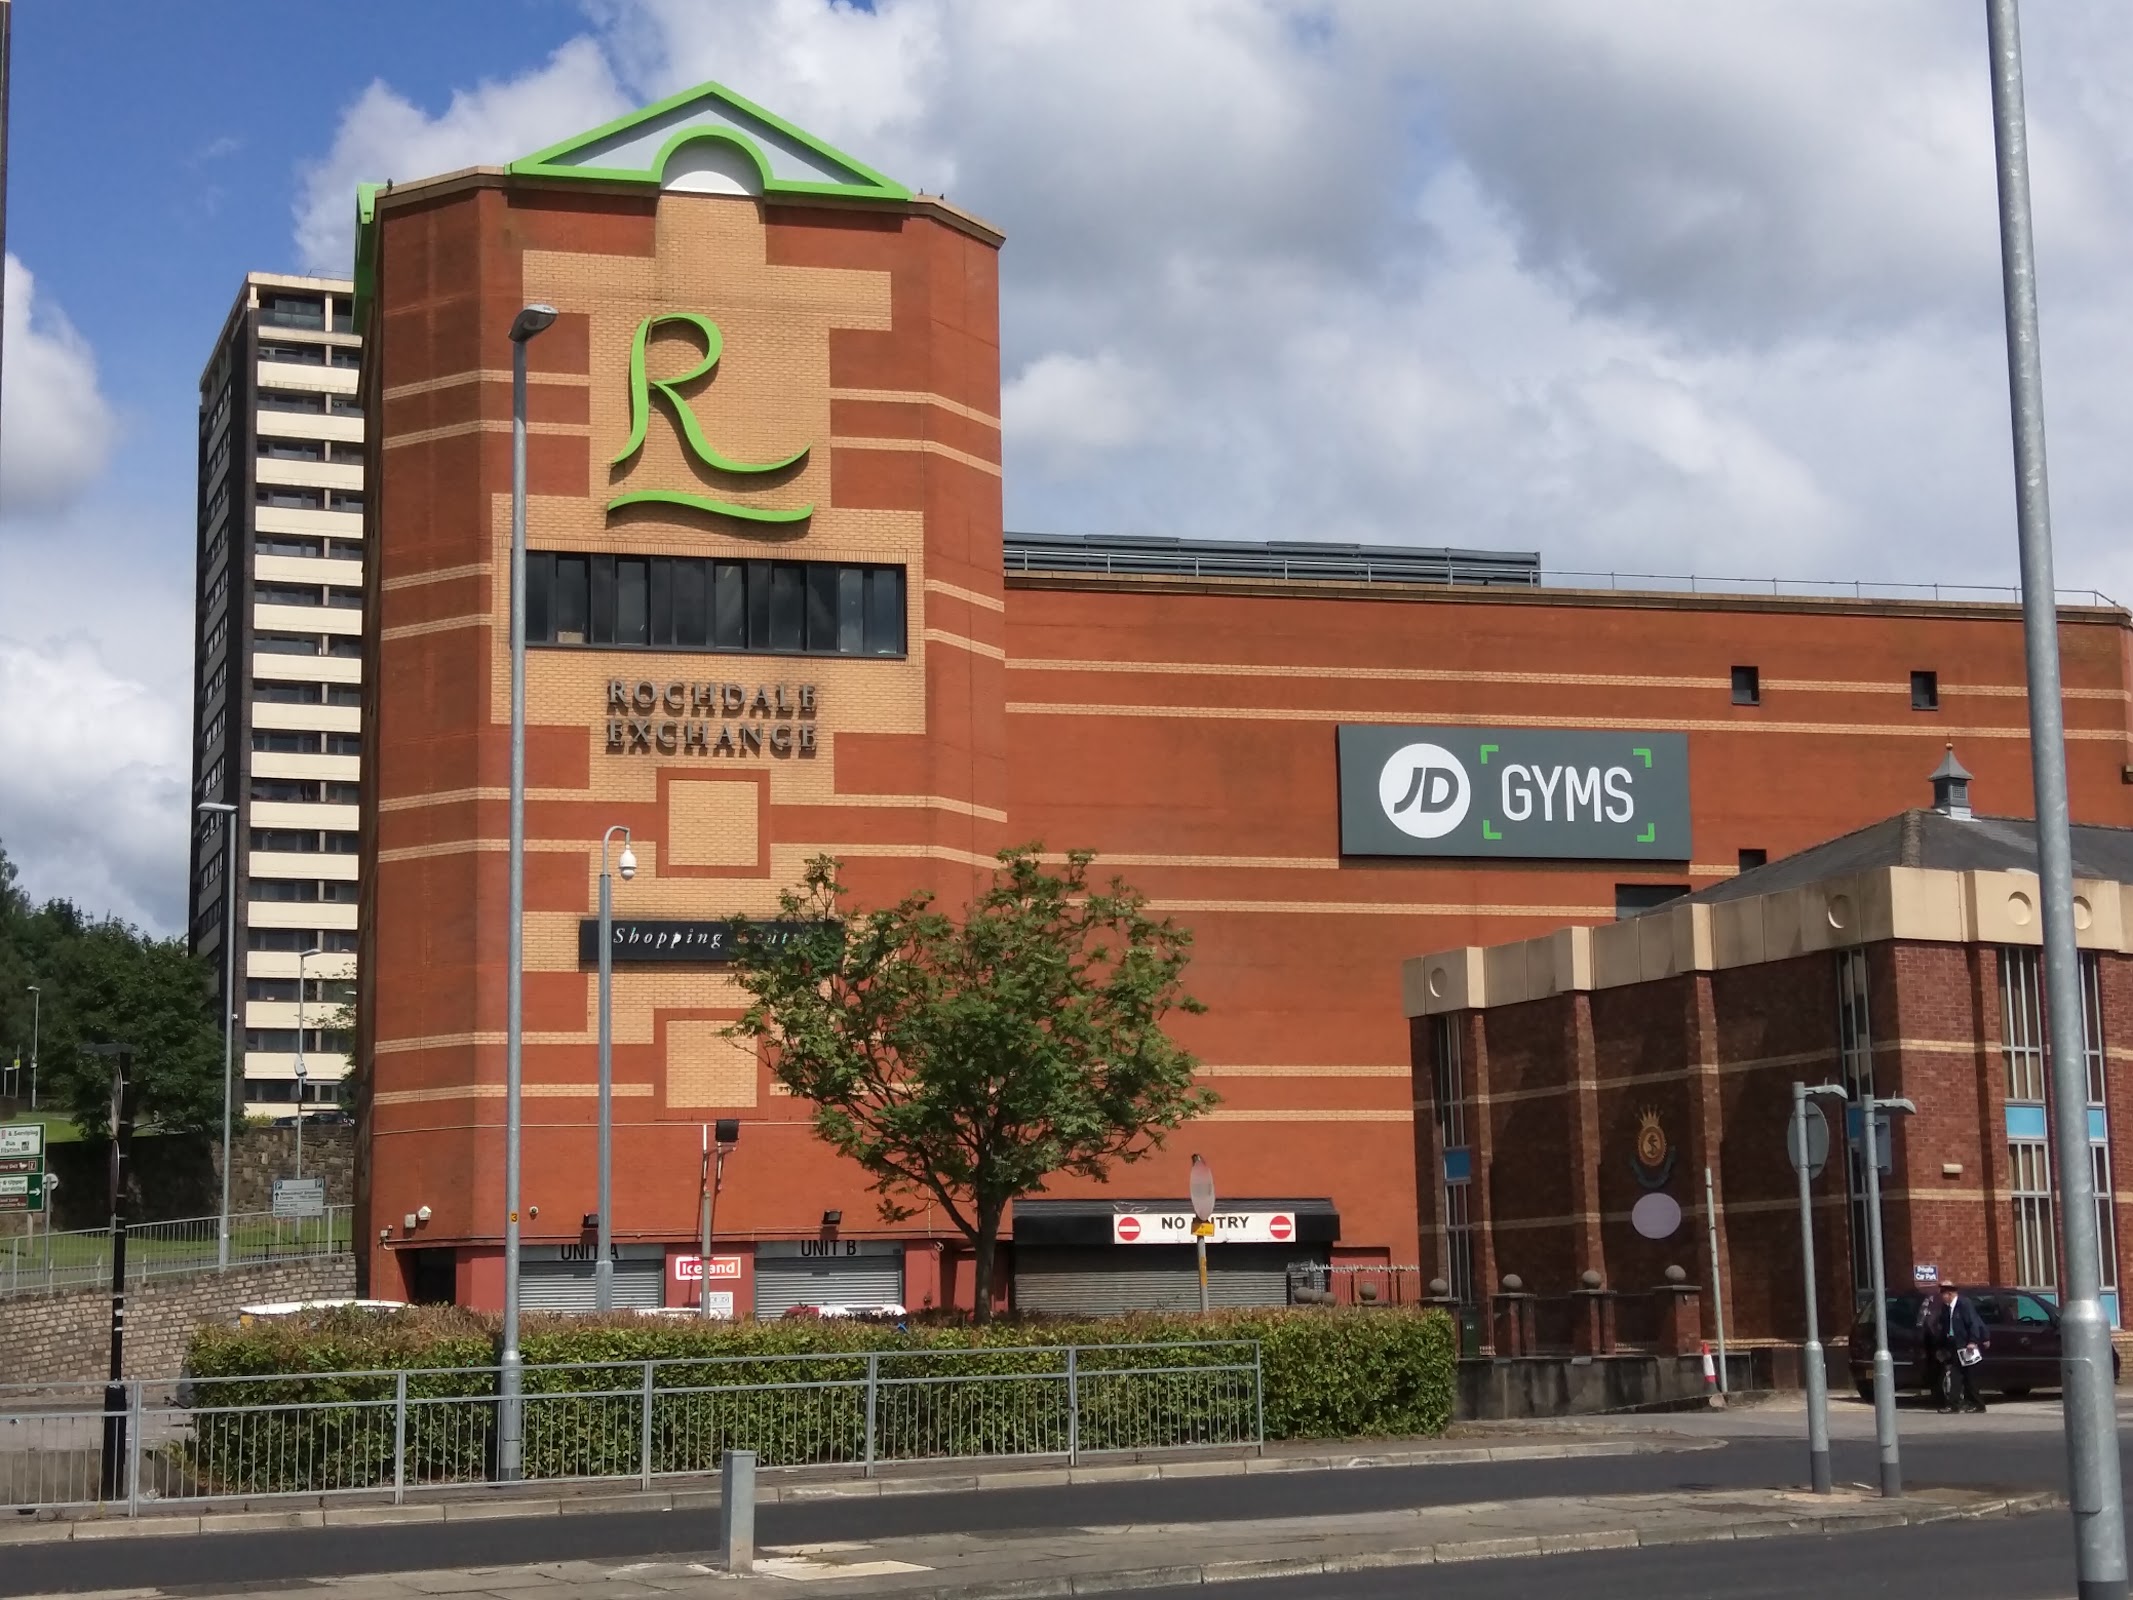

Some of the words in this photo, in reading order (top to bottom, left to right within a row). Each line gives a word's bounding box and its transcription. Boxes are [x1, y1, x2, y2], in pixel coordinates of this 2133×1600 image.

[608, 680, 816, 709] ROCHDALE
[608, 720, 817, 749] EXCHANGE
[1394, 767, 1459, 814] JD
[1502, 764, 1634, 823] GYMS
[613, 927, 723, 948] Shopping
[1161, 1217, 1185, 1230] NO
[561, 1243, 598, 1260] UNIT
[801, 1239, 839, 1256] UNIT
[846, 1239, 857, 1256] B
[682, 1261, 736, 1275] Iceand
